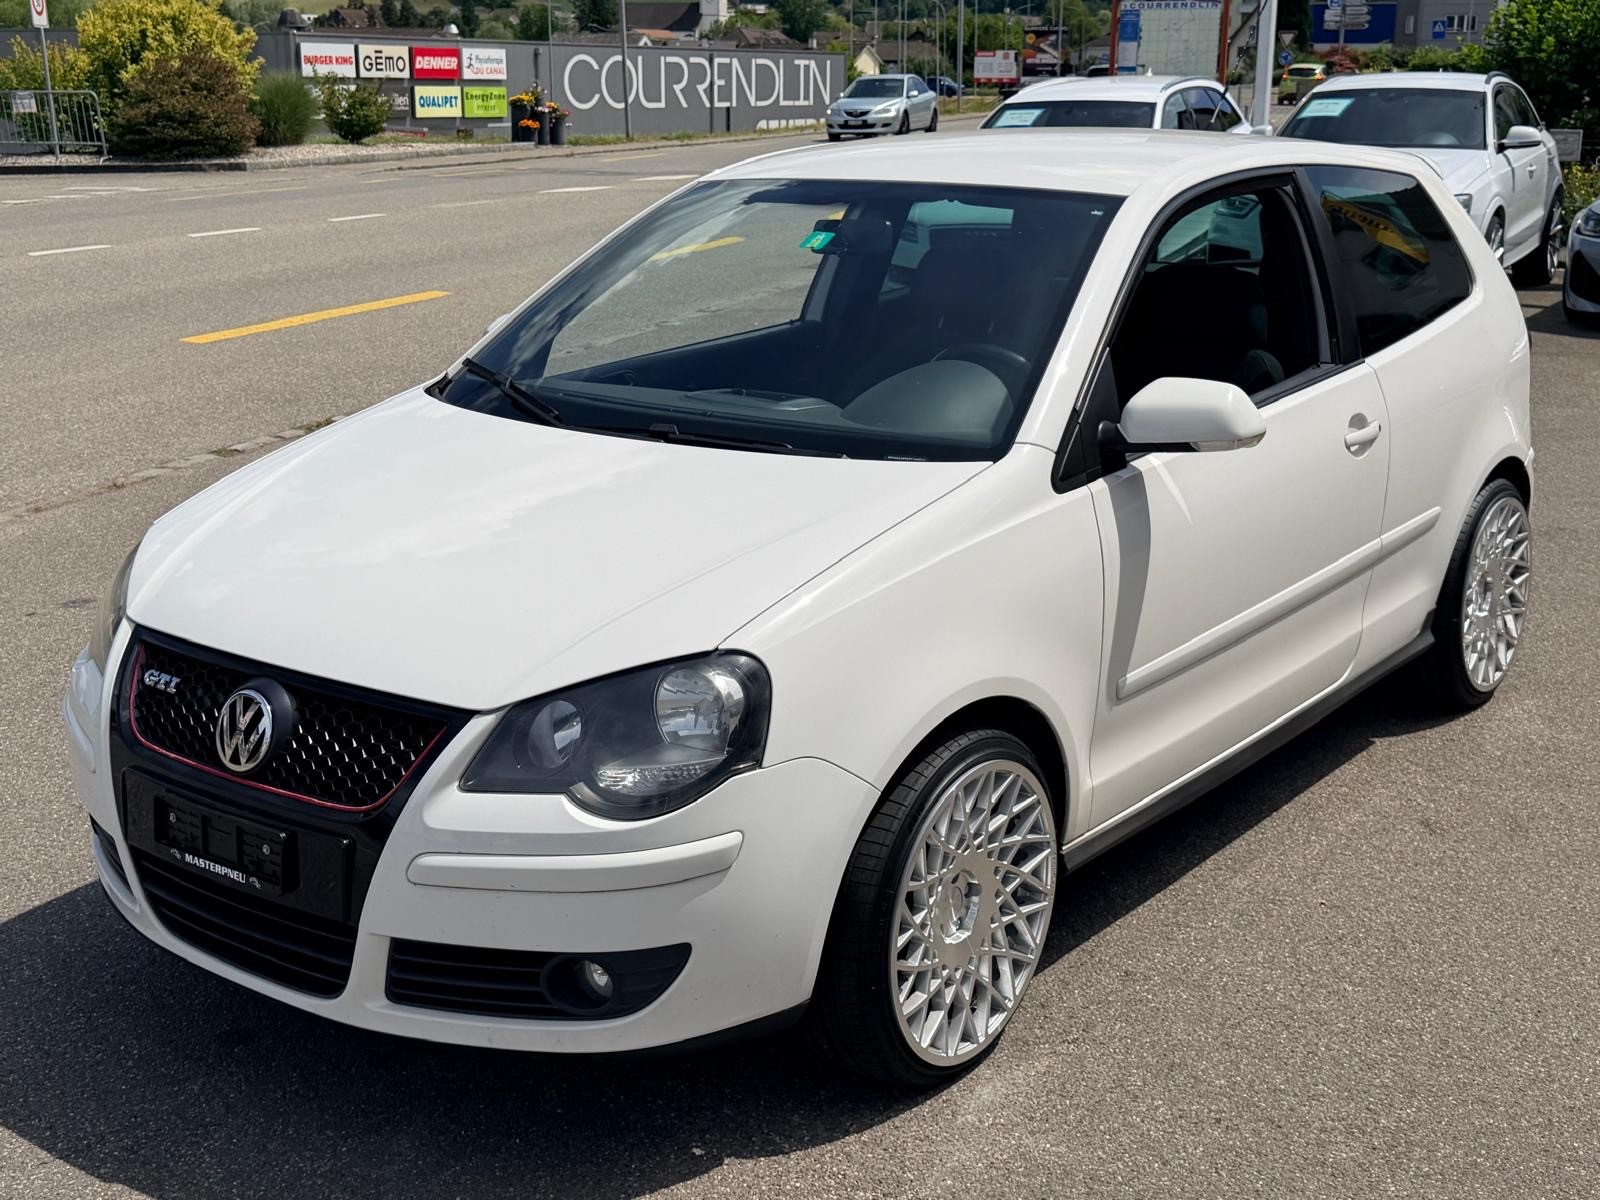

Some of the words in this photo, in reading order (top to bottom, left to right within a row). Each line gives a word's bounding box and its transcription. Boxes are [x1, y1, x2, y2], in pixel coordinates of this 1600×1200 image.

[303, 55, 334, 65] BURGER
[335, 55, 354, 66] KING
[415, 57, 458, 70] DENNER
[564, 53, 831, 110] COURRENDLIN
[418, 95, 459, 108] QUALIPET
[465, 92, 506, 102] EnergyZone
[144, 669, 181, 694] GTI
[184, 853, 246, 884] MASTERPNEU
